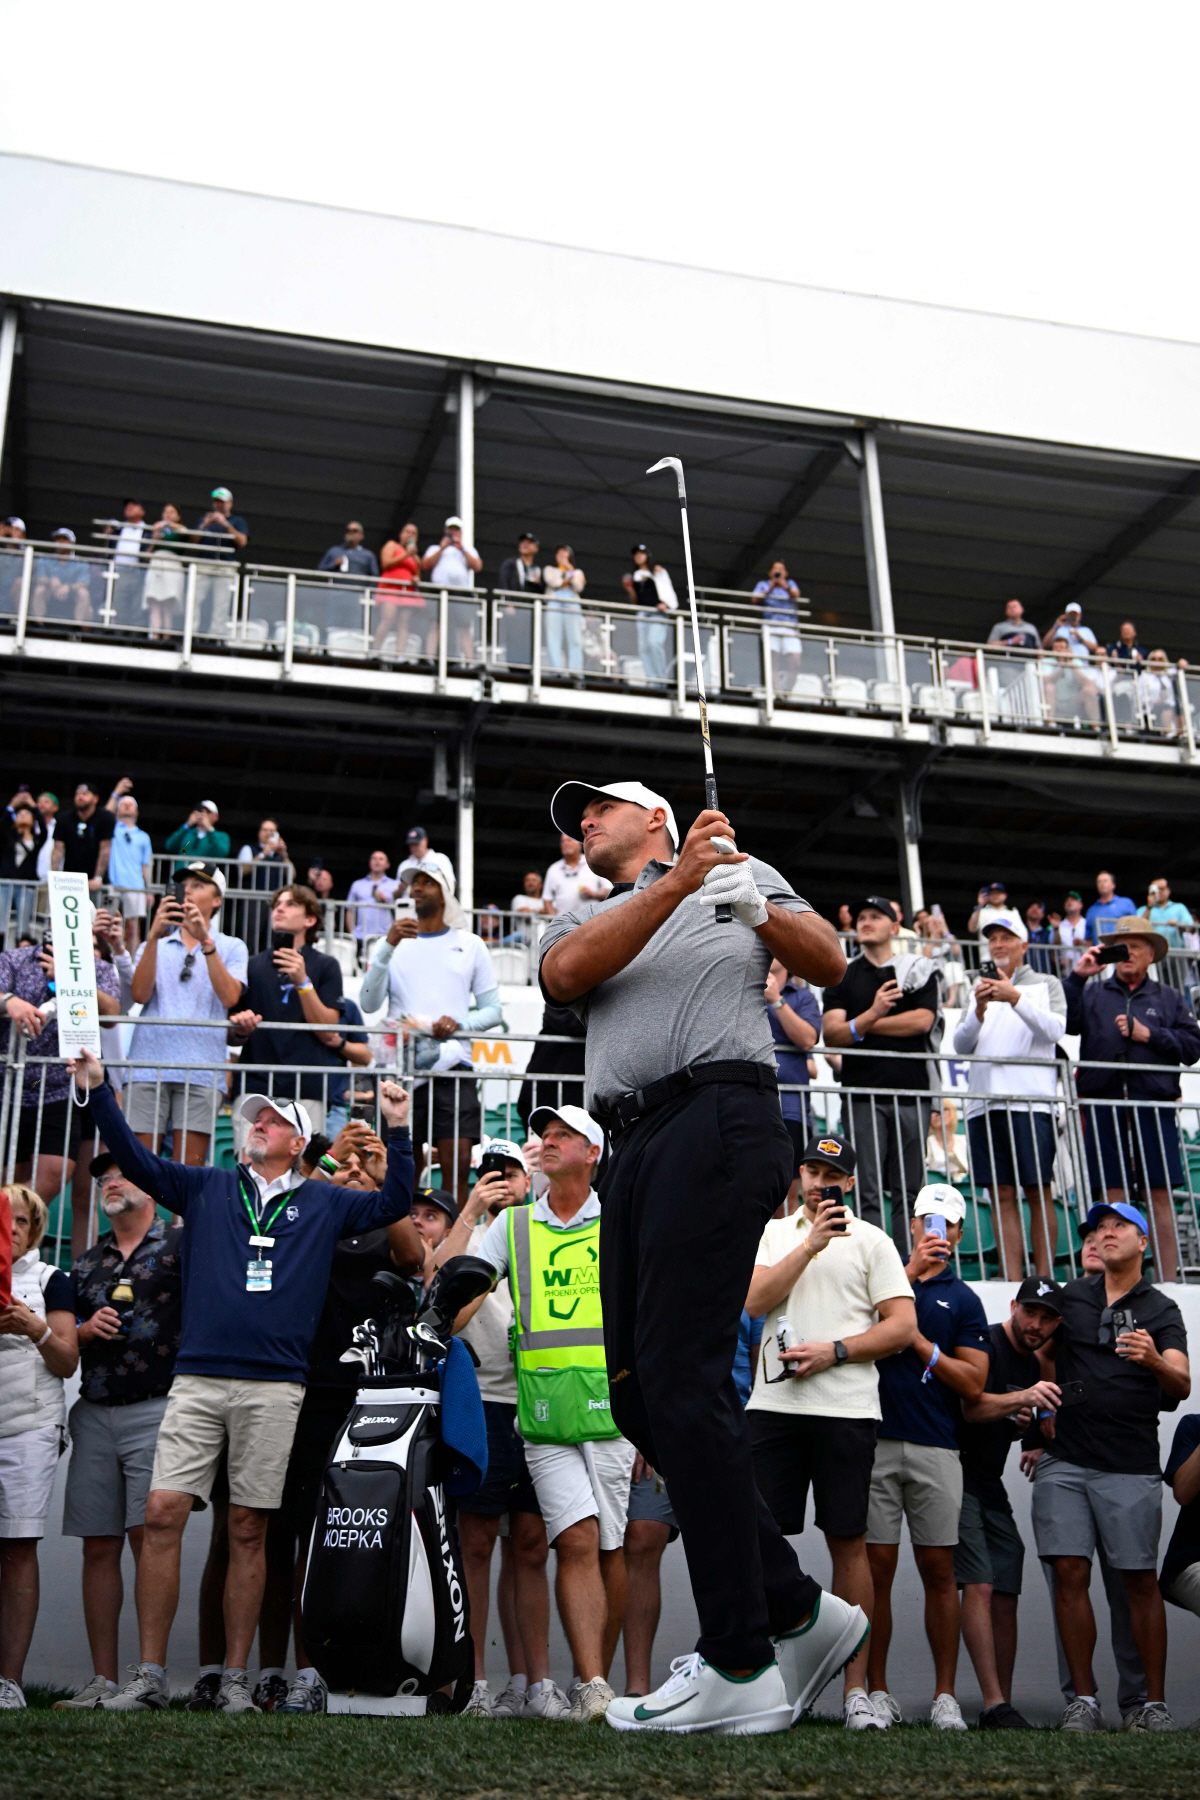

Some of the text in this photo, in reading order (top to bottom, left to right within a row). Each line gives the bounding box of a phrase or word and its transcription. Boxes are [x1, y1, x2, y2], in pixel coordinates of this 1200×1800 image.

[63, 895, 82, 982] QUIET
[60, 988, 94, 997] PLEASE
[471, 1041, 513, 1064] M
[542, 1266, 600, 1287] WM
[544, 1288, 578, 1297] PHOENIX
[352, 1416, 399, 1428] SRIXON
[326, 1507, 388, 1526] BROOKS
[323, 1529, 383, 1549] KOEPKA
[427, 1482, 466, 1644] SRIXON
